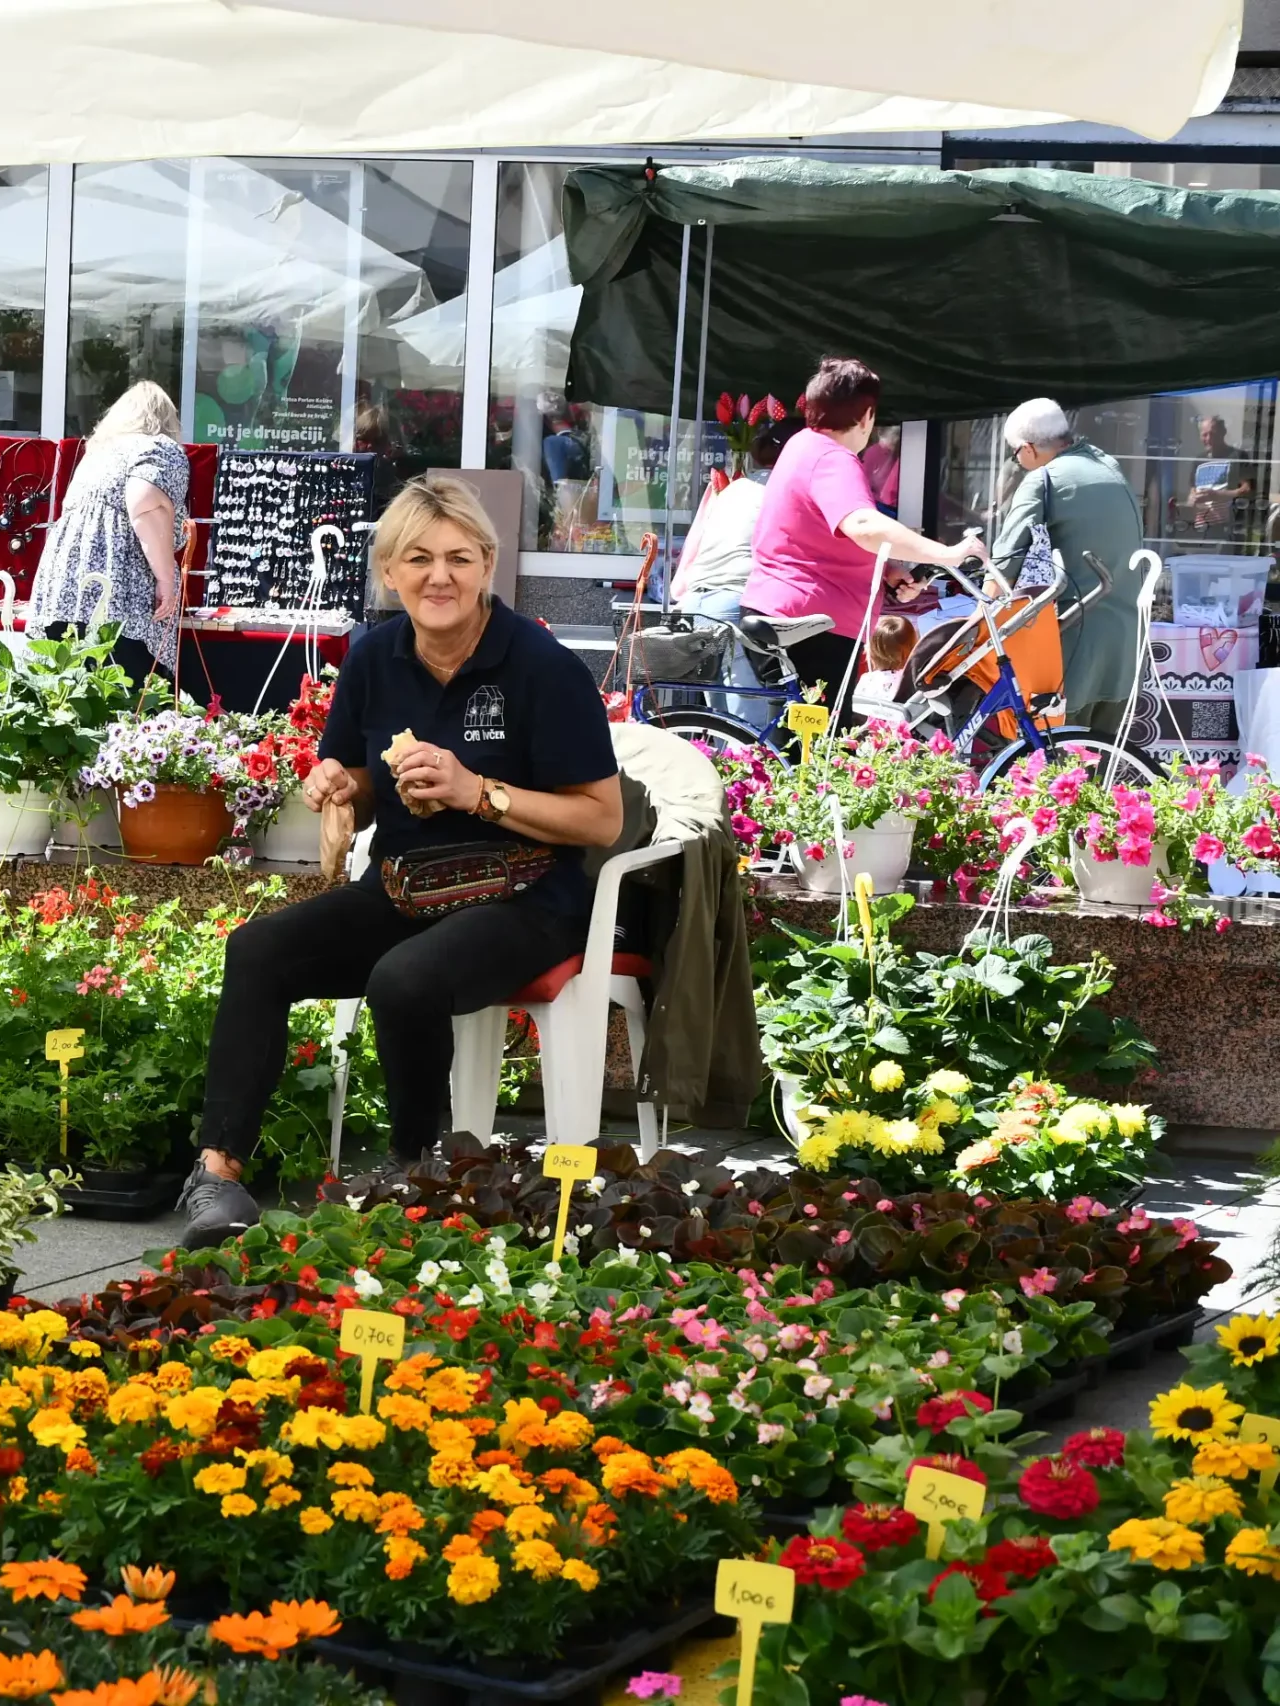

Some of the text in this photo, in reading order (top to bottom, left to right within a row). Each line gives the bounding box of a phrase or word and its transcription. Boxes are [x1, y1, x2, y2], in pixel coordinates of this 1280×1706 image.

[207, 423, 327, 444] Put je drugačiji,
[627, 447, 656, 461] Put
[353, 1325, 395, 1347] 0,70€
[922, 1483, 968, 1515] 2,00€
[729, 1581, 775, 1610] 1,00€
